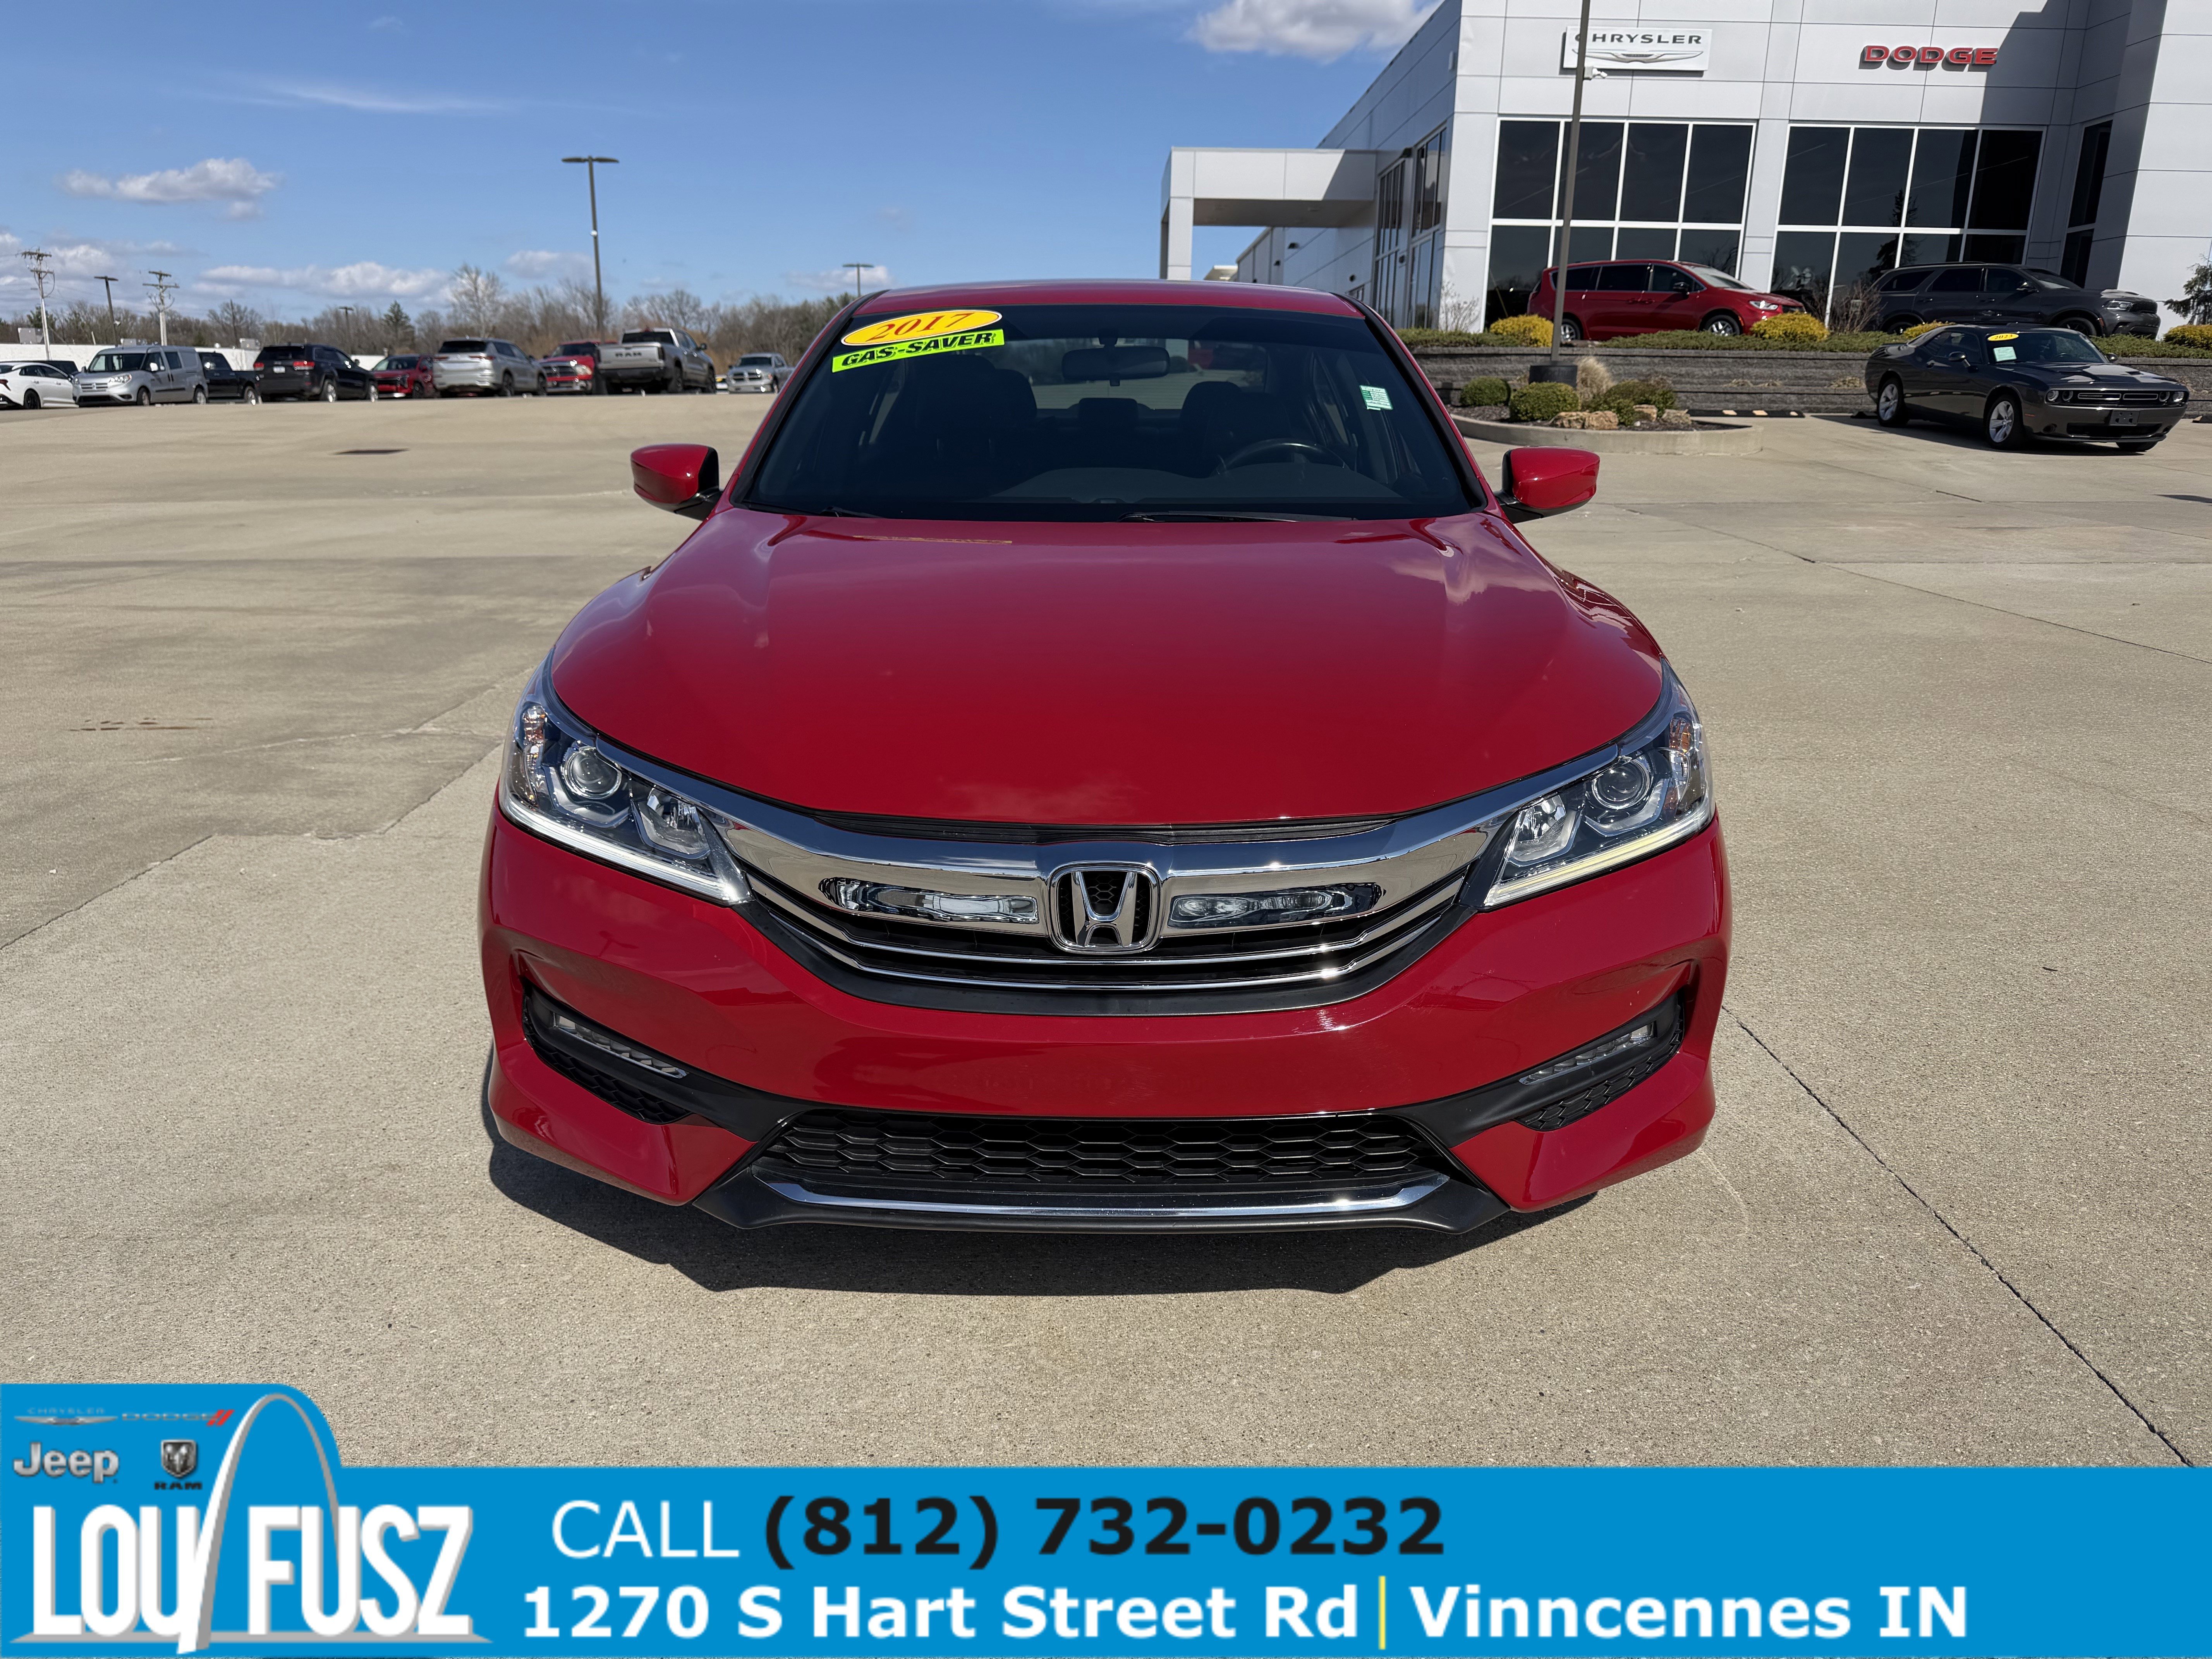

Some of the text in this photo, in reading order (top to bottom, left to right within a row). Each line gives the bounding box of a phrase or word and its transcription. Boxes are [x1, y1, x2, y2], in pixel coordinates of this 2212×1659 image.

[1861, 45, 1999, 65] DODGE
[865, 313, 975, 342] 2017
[842, 332, 996, 366] GAS-SAVER
